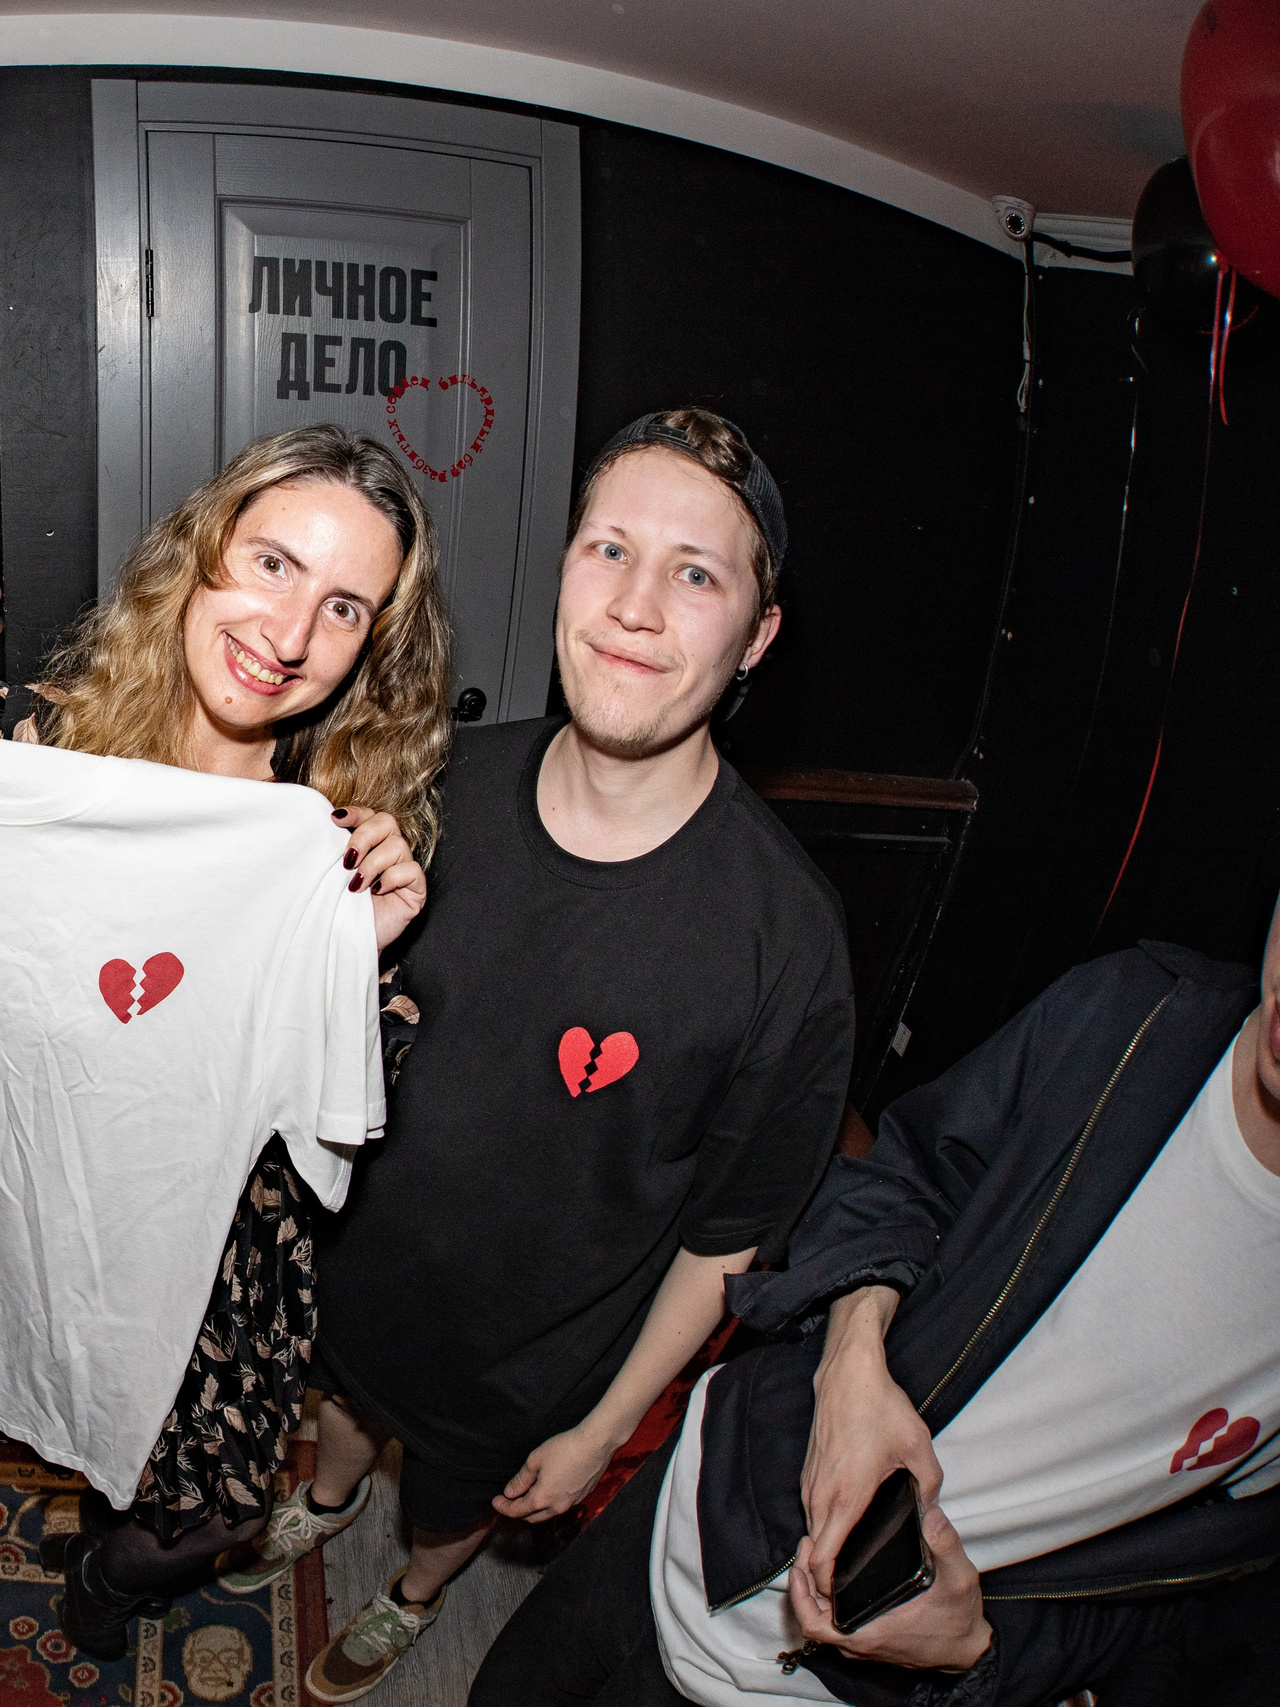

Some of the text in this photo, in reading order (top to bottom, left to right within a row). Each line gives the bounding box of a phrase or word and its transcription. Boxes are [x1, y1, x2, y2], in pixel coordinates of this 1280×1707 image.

[249, 256, 438, 328] ЛИЧНОЕ
[277, 332, 407, 400] ДЕЛО
[386, 374, 495, 483] бильярдный бар разбитых сердец
